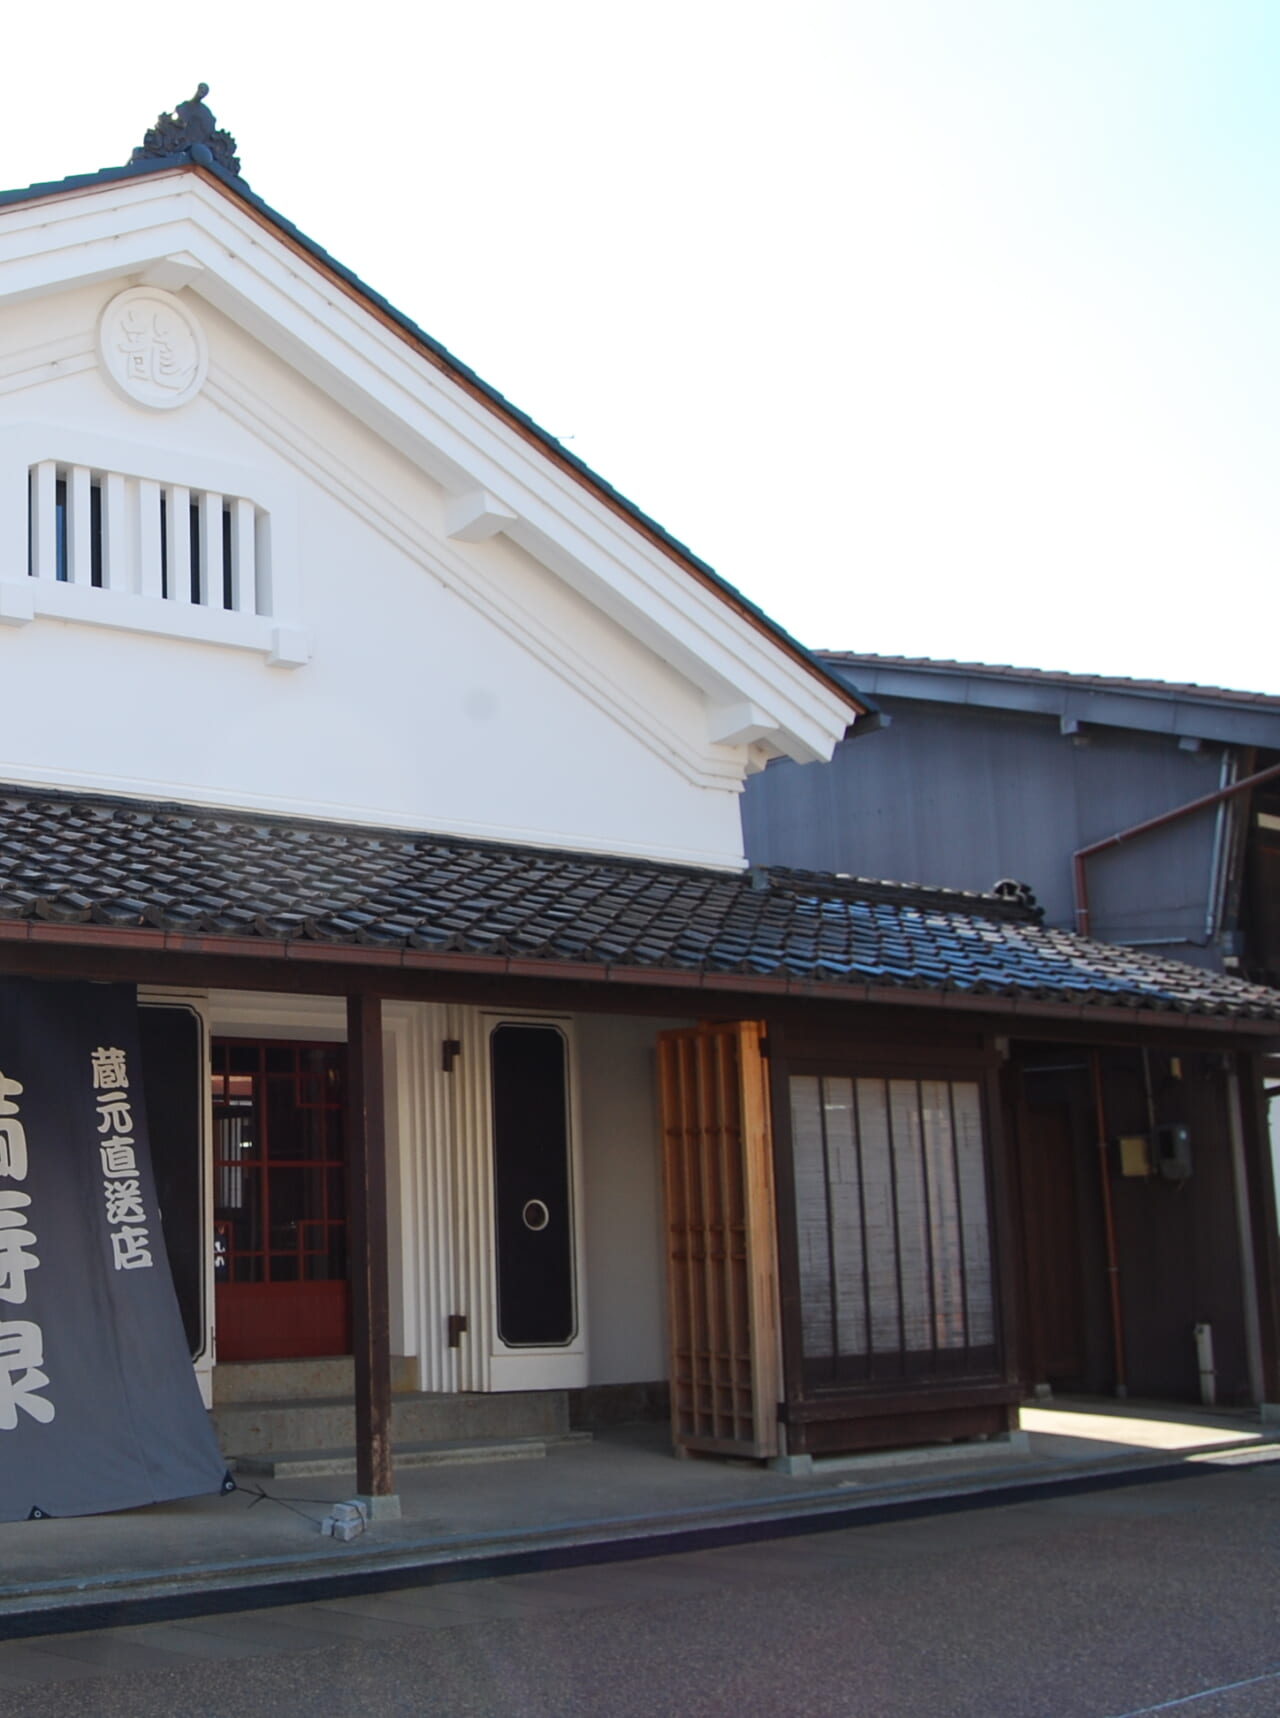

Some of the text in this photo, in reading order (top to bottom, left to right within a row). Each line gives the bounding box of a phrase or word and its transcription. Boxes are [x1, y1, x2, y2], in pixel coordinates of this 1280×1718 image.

[91, 1047, 153, 1270] 蔵元直送店
